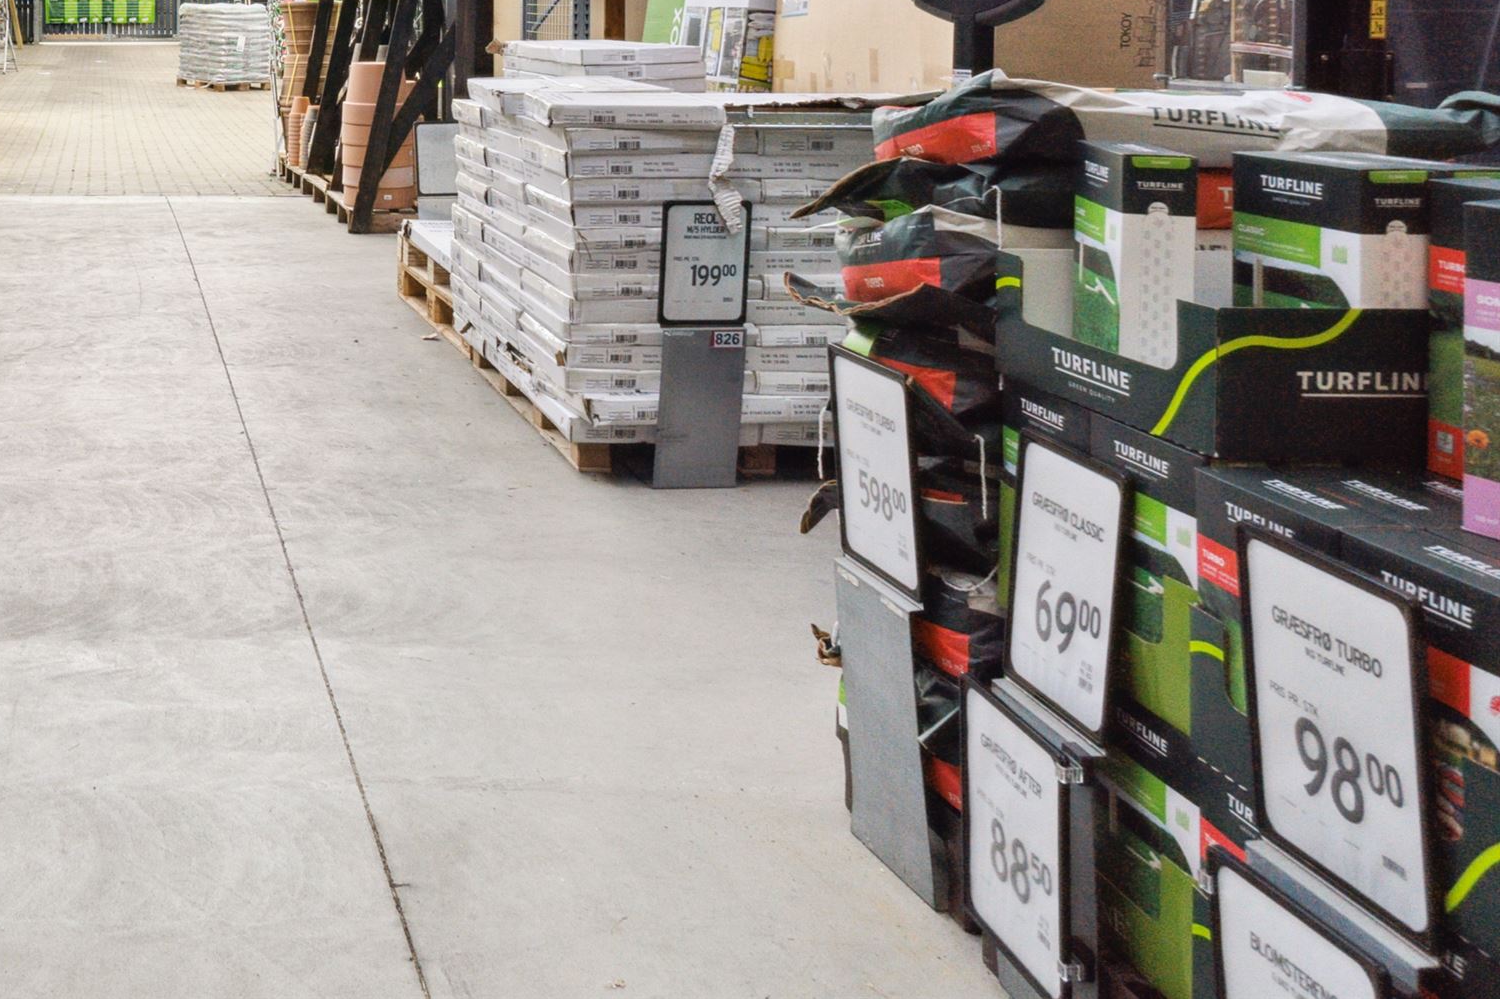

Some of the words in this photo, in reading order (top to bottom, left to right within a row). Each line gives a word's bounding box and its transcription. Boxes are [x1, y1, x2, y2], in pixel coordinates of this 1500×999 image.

[1137, 180, 1184, 189] TURFLINE
[1260, 174, 1324, 195] TURFLINE
[694, 212, 719, 224] REOL
[715, 333, 740, 345] 826
[1051, 346, 1131, 390] TURFLINE
[1297, 371, 1428, 391] TURFLIN
[1020, 397, 1065, 427] TURFLINE
[1114, 440, 1170, 474] TURFLINE
[1070, 513, 1104, 542] CLASSIC
[1272, 605, 1332, 652] GRÆSFRØ
[1335, 638, 1382, 678] TURBO
[1019, 767, 1042, 799] AFTER
